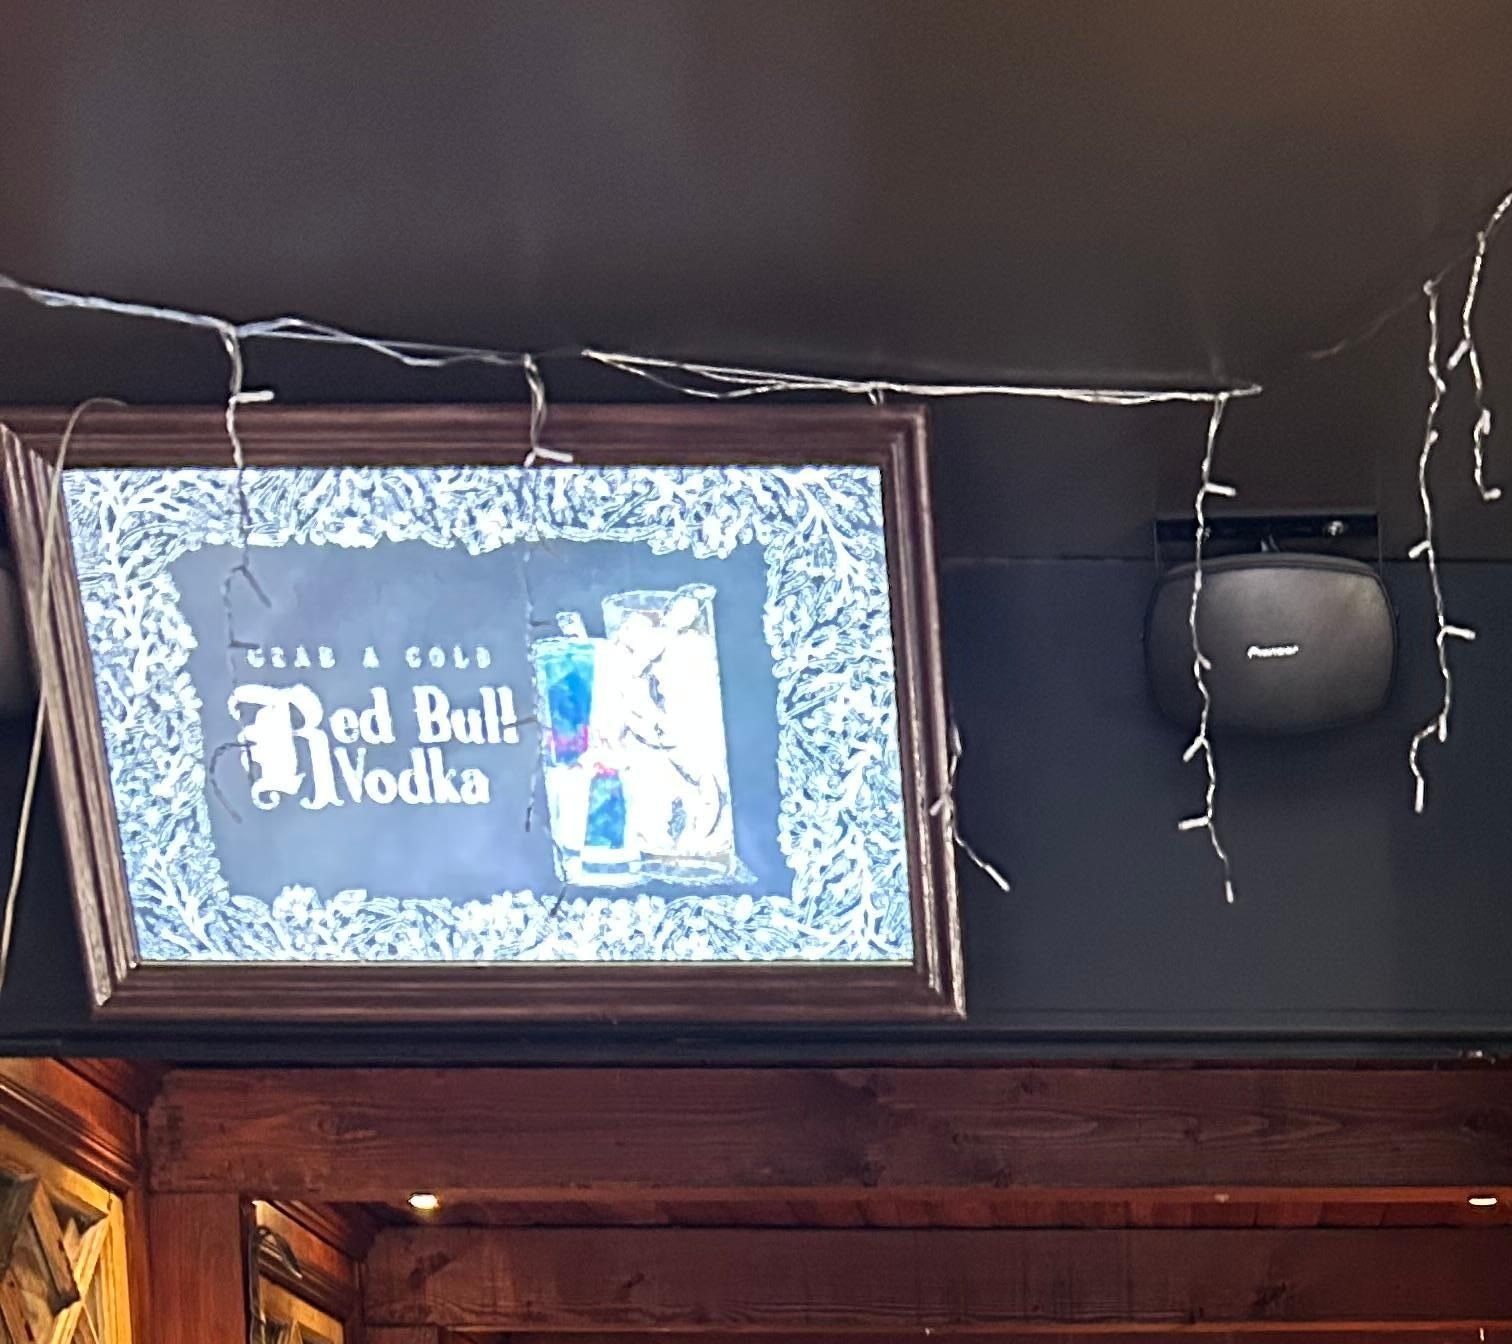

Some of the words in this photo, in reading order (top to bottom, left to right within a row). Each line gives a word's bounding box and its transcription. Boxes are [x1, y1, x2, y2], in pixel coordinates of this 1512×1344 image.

[247, 646, 336, 668] GRAB
[363, 646, 379, 668] A
[405, 645, 491, 668] COLD
[227, 684, 396, 810] Red
[413, 685, 519, 744] Bull
[333, 747, 490, 804] Vodka
